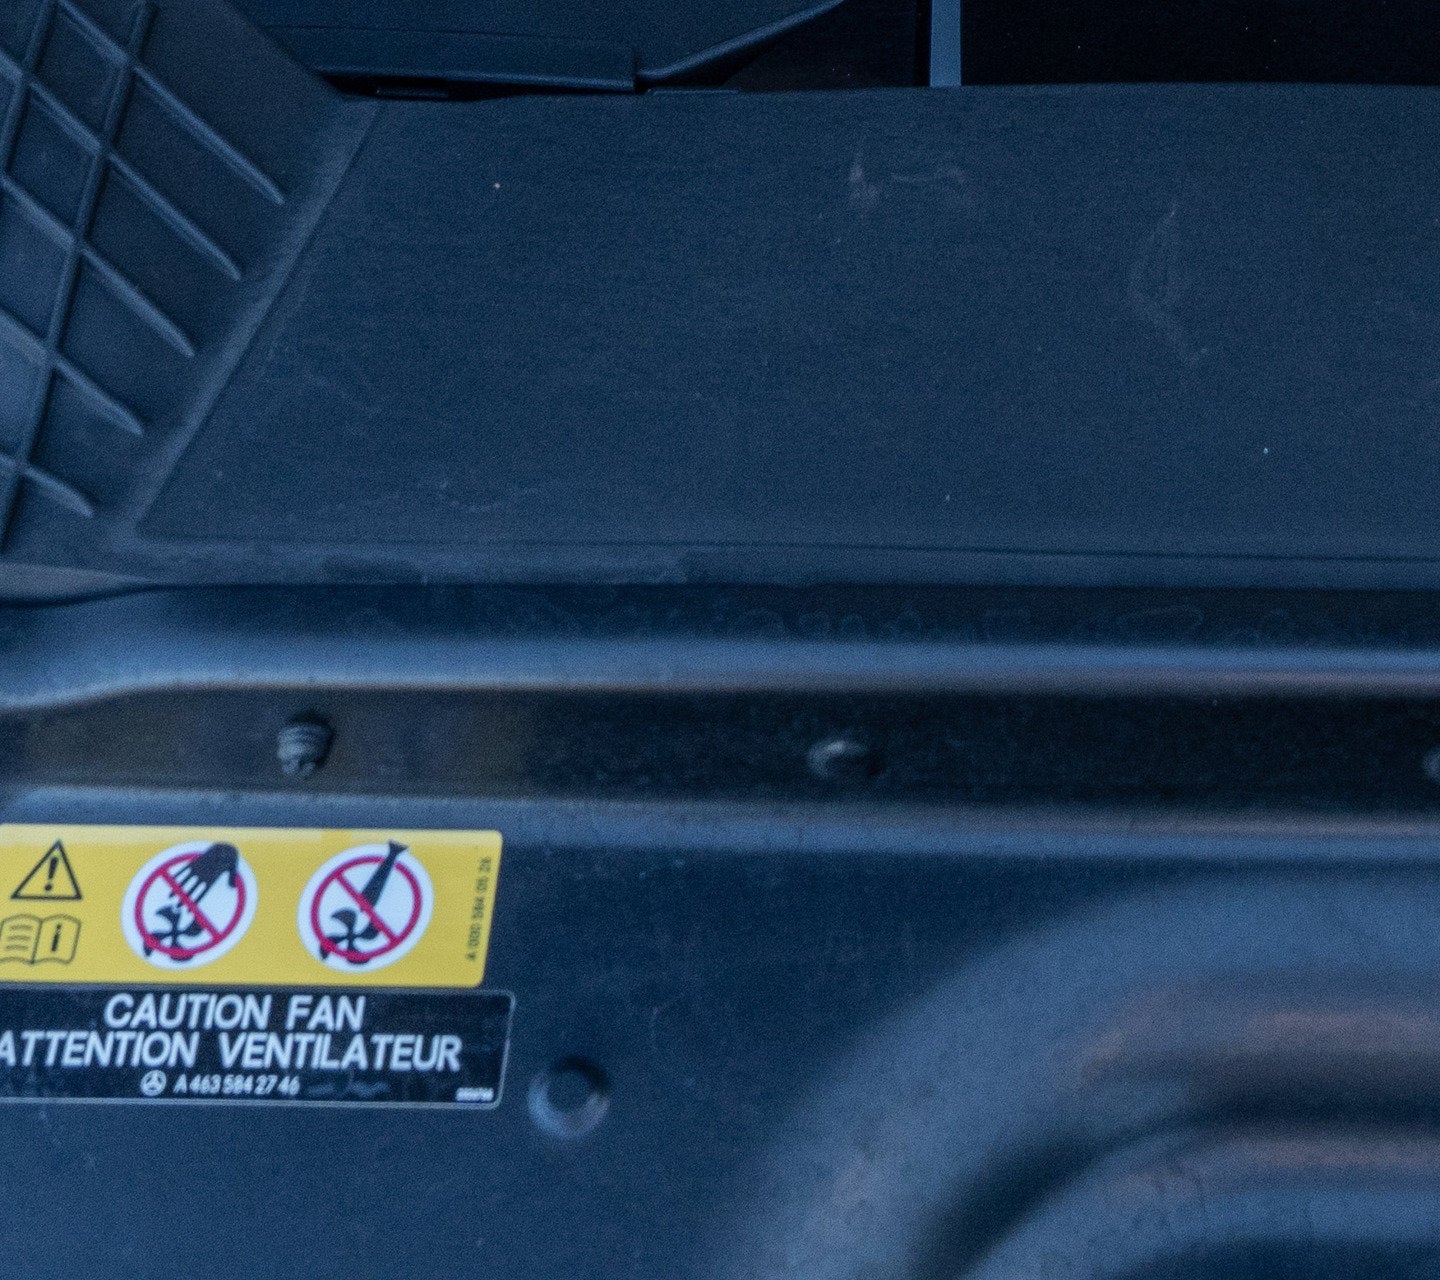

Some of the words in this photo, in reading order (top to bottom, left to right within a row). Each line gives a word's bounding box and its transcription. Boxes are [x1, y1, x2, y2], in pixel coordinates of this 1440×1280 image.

[104, 992, 273, 1031] CAUTION
[286, 995, 366, 1032] FAN
[218, 1032, 463, 1072] VENTILATEUR
[172, 1074, 188, 1093] A
[189, 1074, 220, 1094] 463
[221, 1075, 253, 1095] 584
[253, 1075, 277, 1095] 27
[276, 1075, 301, 1096] 46
